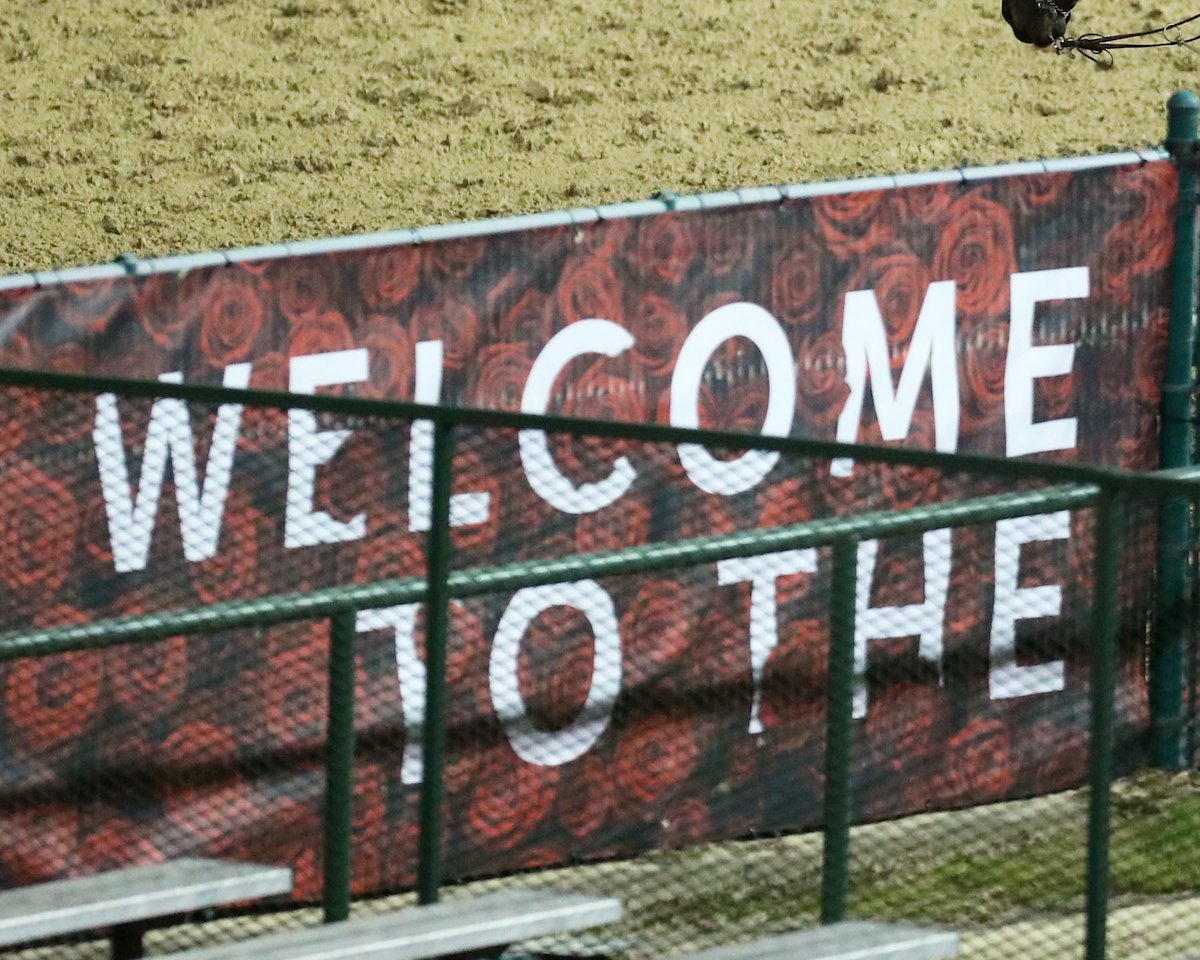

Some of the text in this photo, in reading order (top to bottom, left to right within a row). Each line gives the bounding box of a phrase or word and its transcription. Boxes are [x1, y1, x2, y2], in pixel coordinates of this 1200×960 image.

[93, 265, 1090, 573] WELCOME
[356, 509, 1071, 785] TO THE
